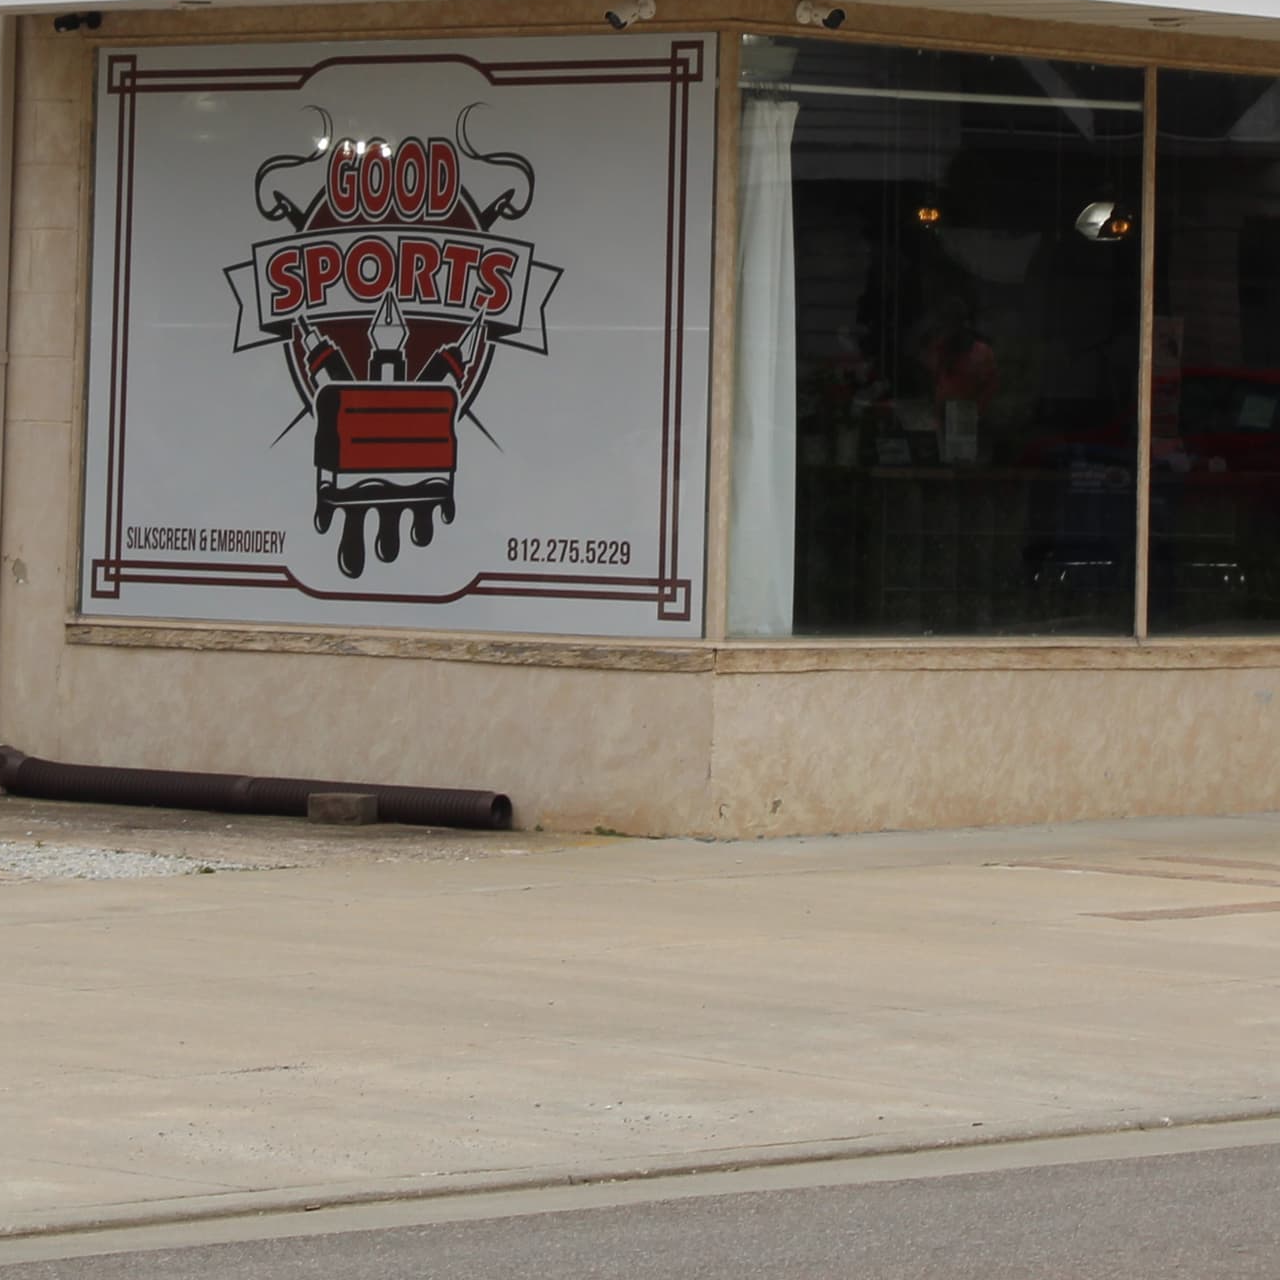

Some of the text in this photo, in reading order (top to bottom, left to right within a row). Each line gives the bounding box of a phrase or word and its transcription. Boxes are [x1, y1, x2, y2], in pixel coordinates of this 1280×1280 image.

[328, 137, 459, 219] GOOD
[266, 235, 519, 315] SPORTS
[126, 526, 286, 554] SILKSCREEN & EMBROIDERY
[507, 537, 631, 565] 812.275.5229
